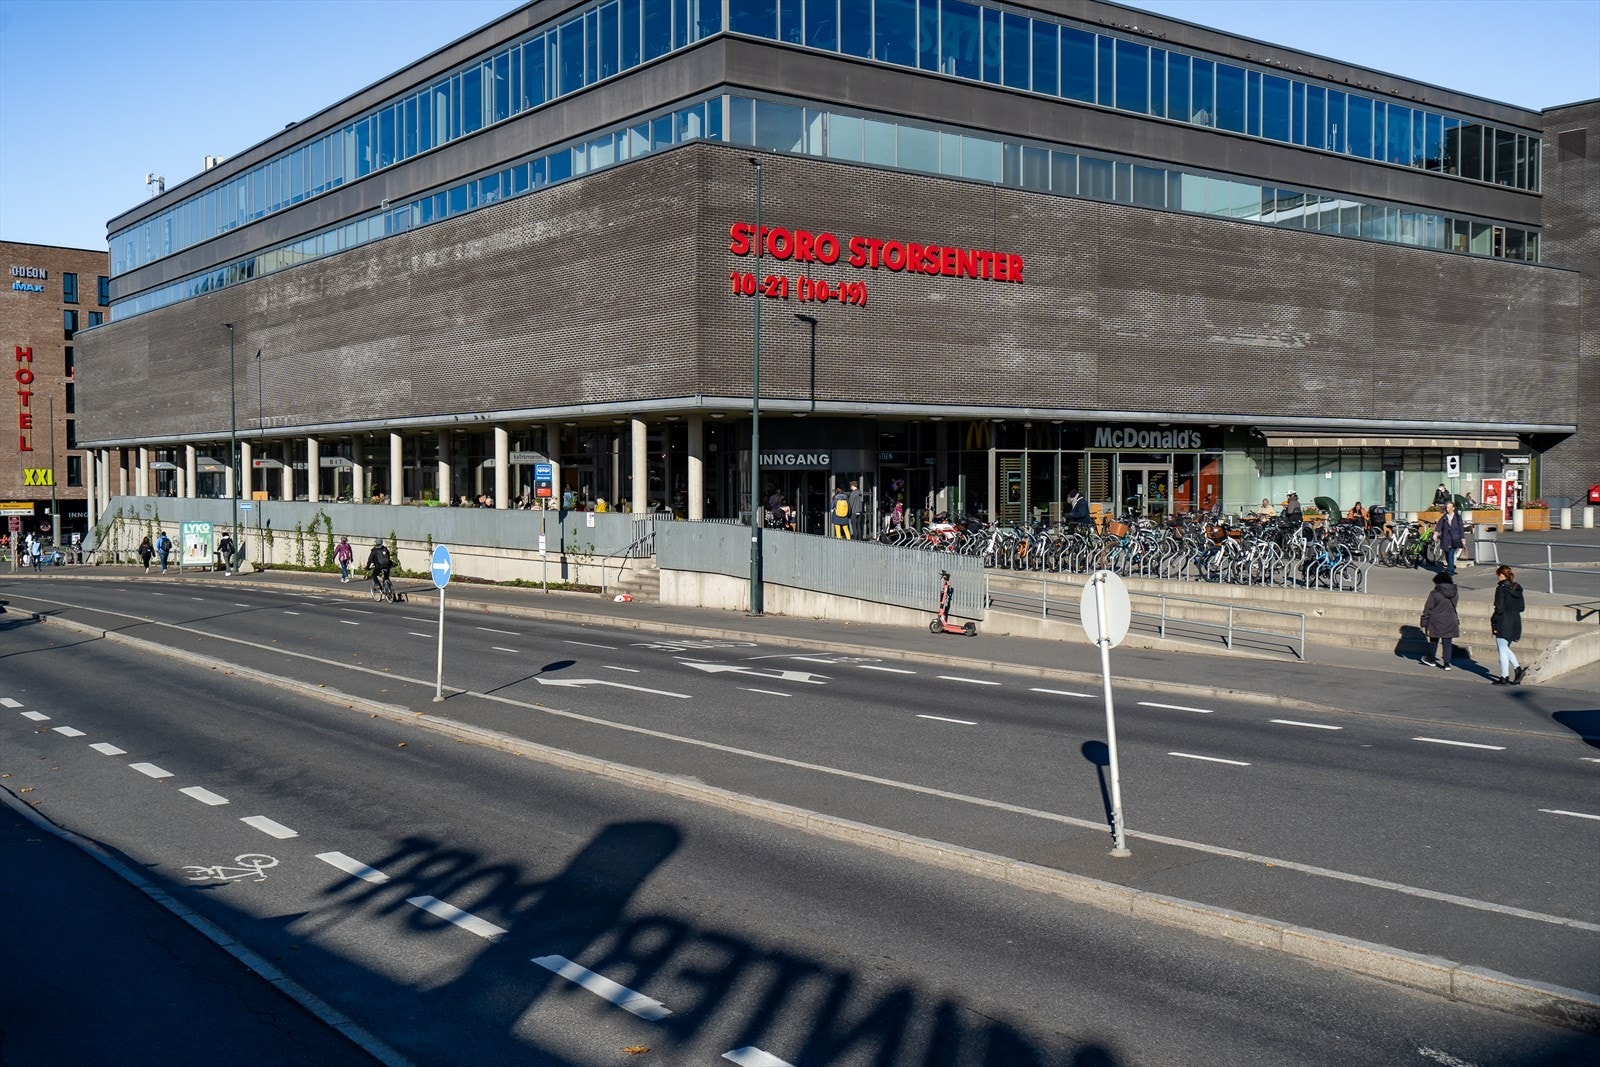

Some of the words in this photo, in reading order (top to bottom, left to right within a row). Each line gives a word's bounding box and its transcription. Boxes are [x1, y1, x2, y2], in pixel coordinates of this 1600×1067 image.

[908, 15, 1006, 67] SATS
[729, 222, 840, 264] STORO
[847, 236, 1024, 284] STORSENTER
[11, 265, 47, 280] ODEON
[12, 281, 44, 293] IMAX
[729, 271, 789, 299] 10-21
[796, 275, 868, 308] (10-19)
[15, 345, 33, 452] HOTEL
[1094, 426, 1202, 449] McDonald's
[759, 453, 830, 466] INNGANG
[184, 523, 210, 534] LYKO
